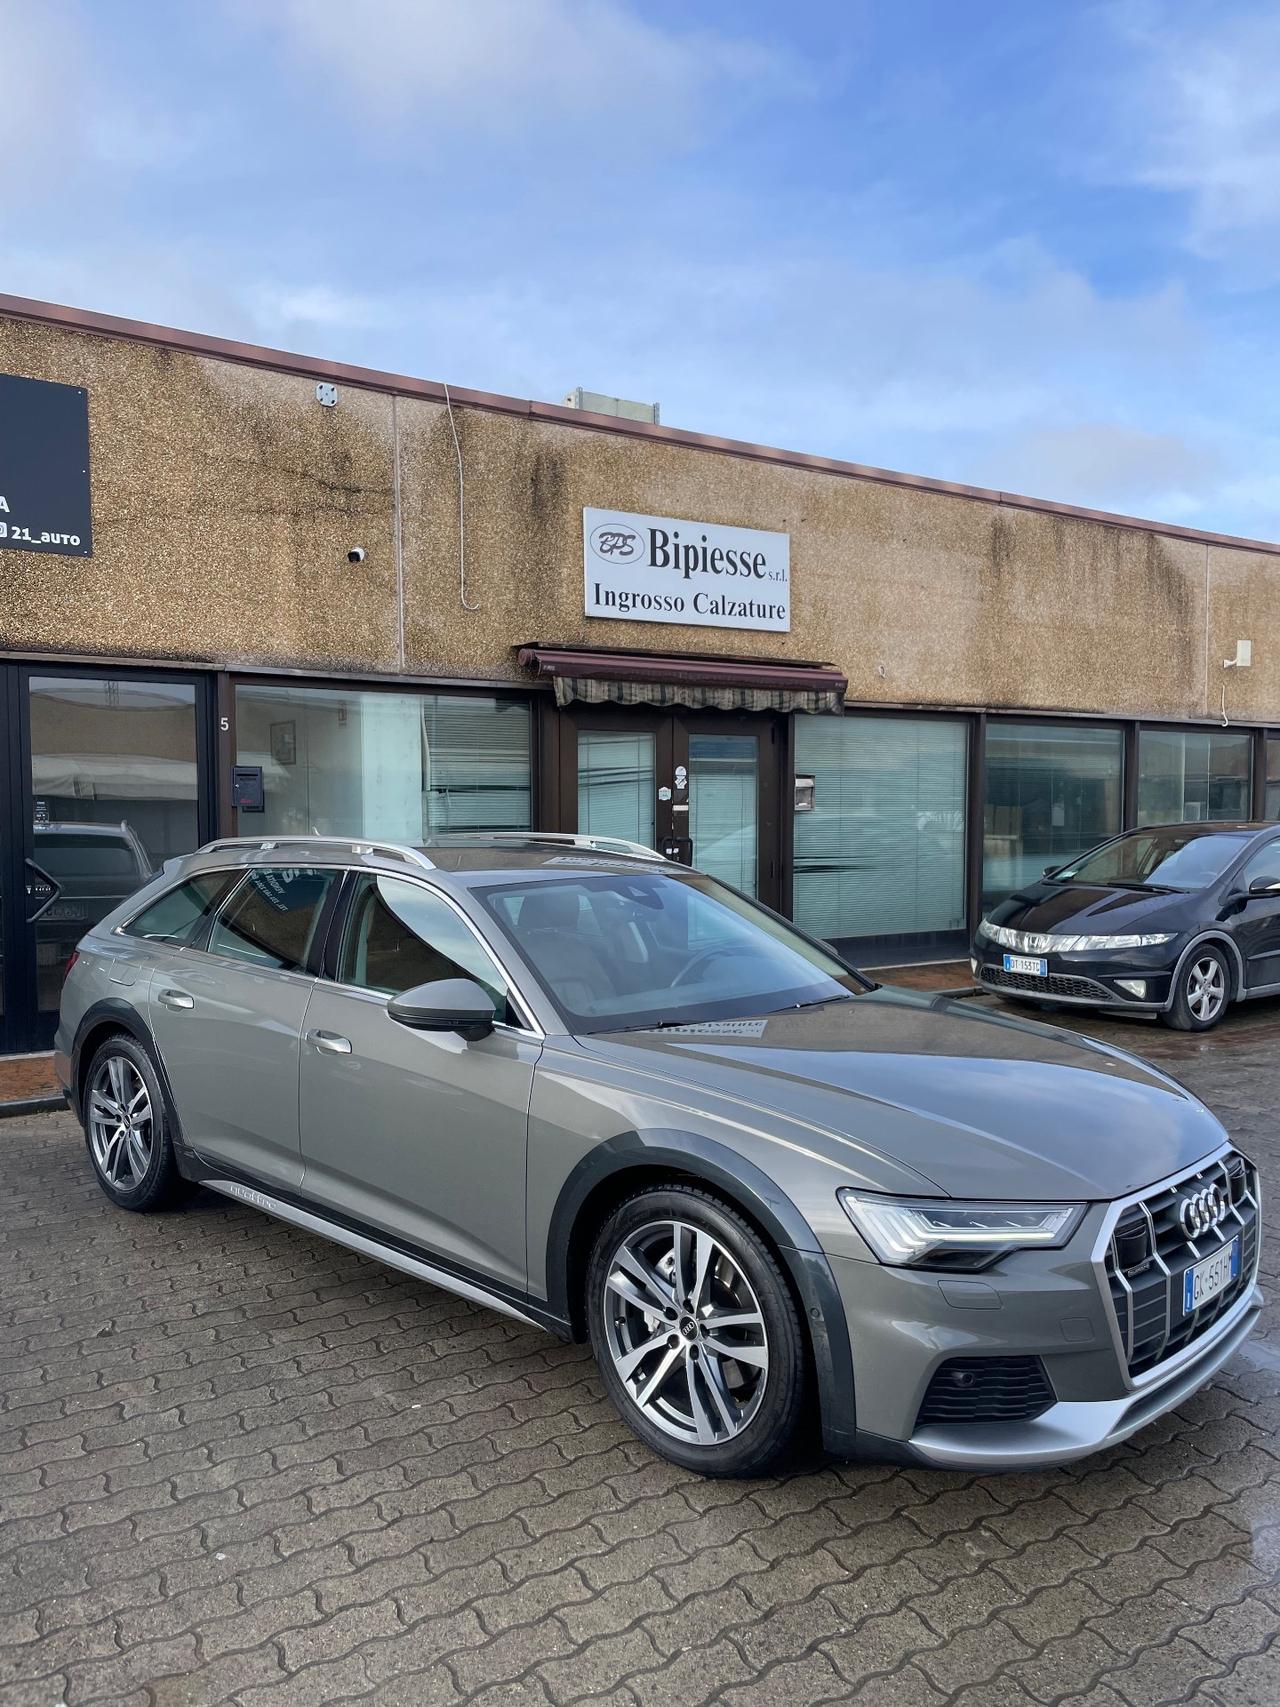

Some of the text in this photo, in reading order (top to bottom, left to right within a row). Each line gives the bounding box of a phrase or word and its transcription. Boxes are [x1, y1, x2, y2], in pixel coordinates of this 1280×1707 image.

[647, 527, 788, 582] Bipiesse s.r.l.
[594, 582, 786, 620] Ingrosso Calzature
[220, 717, 229, 731] 5
